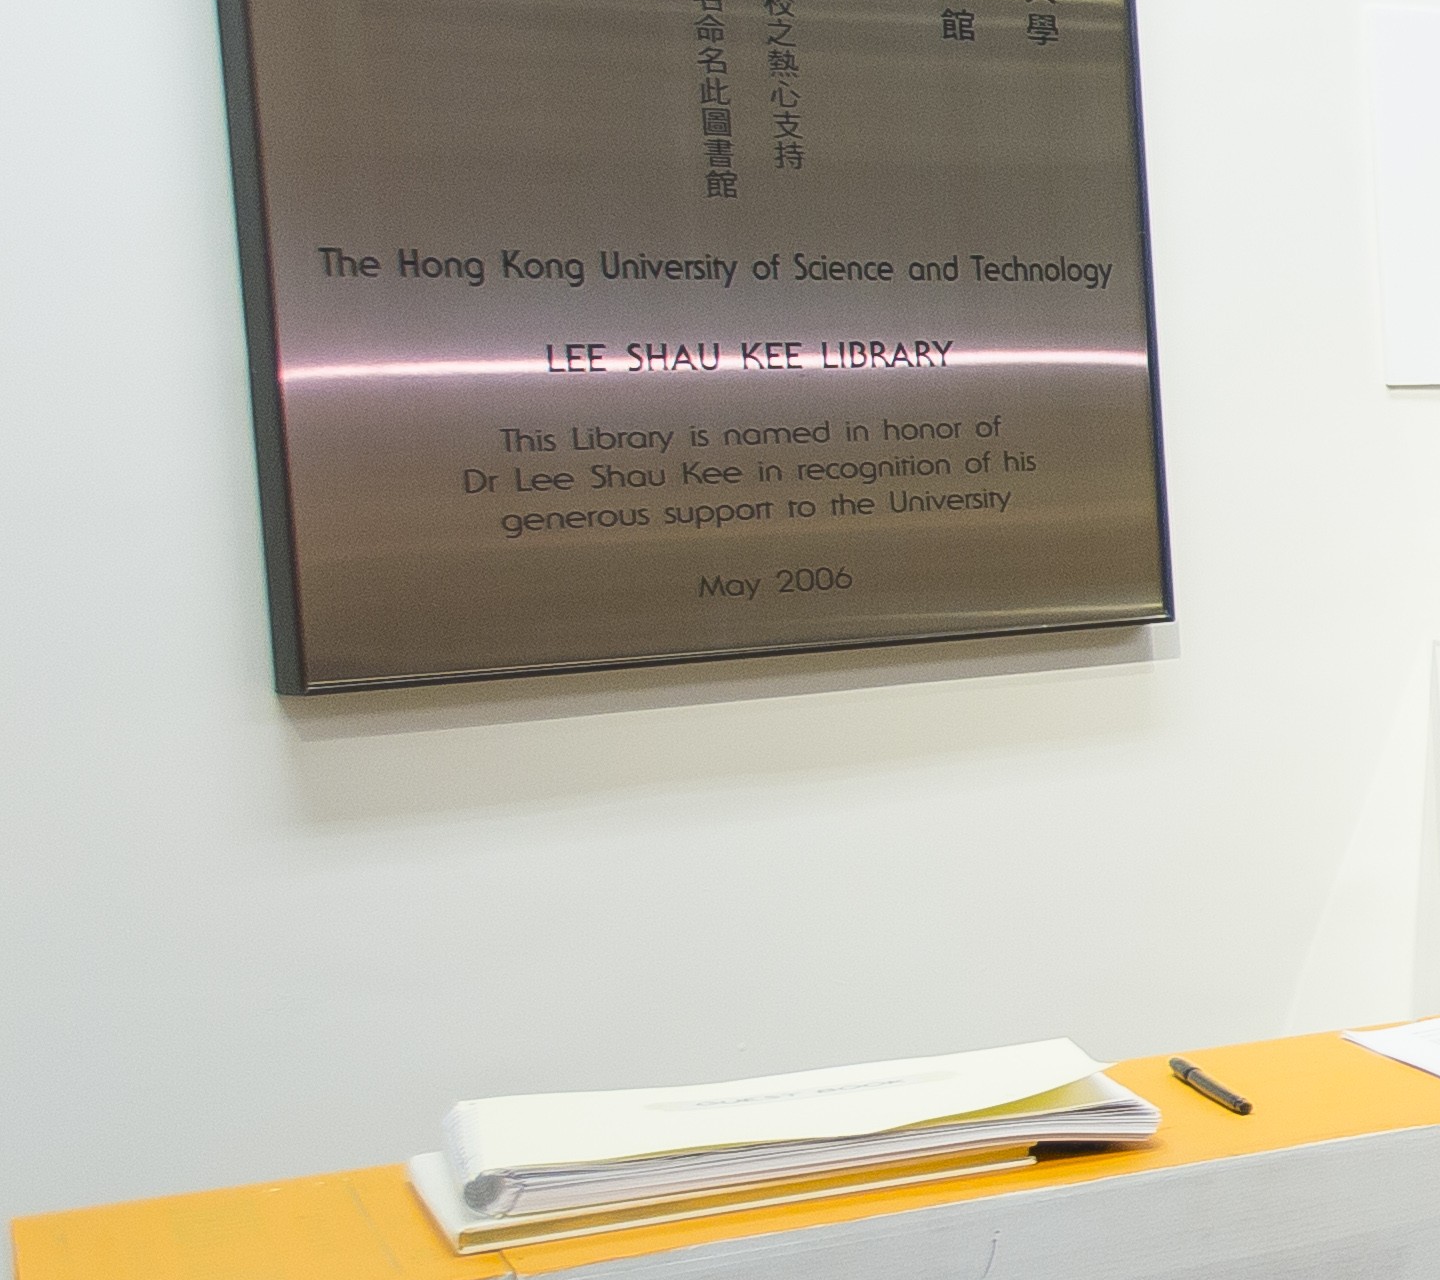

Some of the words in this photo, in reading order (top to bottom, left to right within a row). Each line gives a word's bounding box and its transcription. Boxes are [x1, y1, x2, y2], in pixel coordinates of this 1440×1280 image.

[318, 247, 381, 278] The
[399, 248, 485, 287] Hong
[501, 249, 584, 288] Kong
[600, 251, 737, 288] University
[752, 253, 781, 282] of
[794, 252, 894, 282] Science
[908, 255, 958, 282] and
[970, 254, 1113, 290] Technology
[546, 343, 607, 373] LEE
[627, 342, 719, 372] SHAU
[741, 341, 802, 370] KEE
[821, 339, 953, 369] LIBRARY
[500, 427, 556, 452] This
[572, 426, 674, 454] Library
[690, 425, 709, 447] is
[724, 420, 830, 446] named
[846, 421, 869, 442] in
[883, 419, 962, 441] honor
[975, 414, 1001, 438] of
[464, 468, 498, 494] Dr
[515, 467, 575, 492] Lee
[591, 464, 666, 489] Shau
[683, 461, 743, 485] Kee
[758, 461, 782, 482] in
[797, 455, 951, 484] recognition
[965, 450, 991, 474] of
[1004, 450, 1037, 472] his
[501, 507, 649, 538] generous
[665, 500, 773, 529] support
[788, 500, 816, 518] to
[831, 493, 876, 517] the
[889, 488, 1011, 513] University
[699, 575, 761, 600] May
[776, 567, 853, 593] 2006
